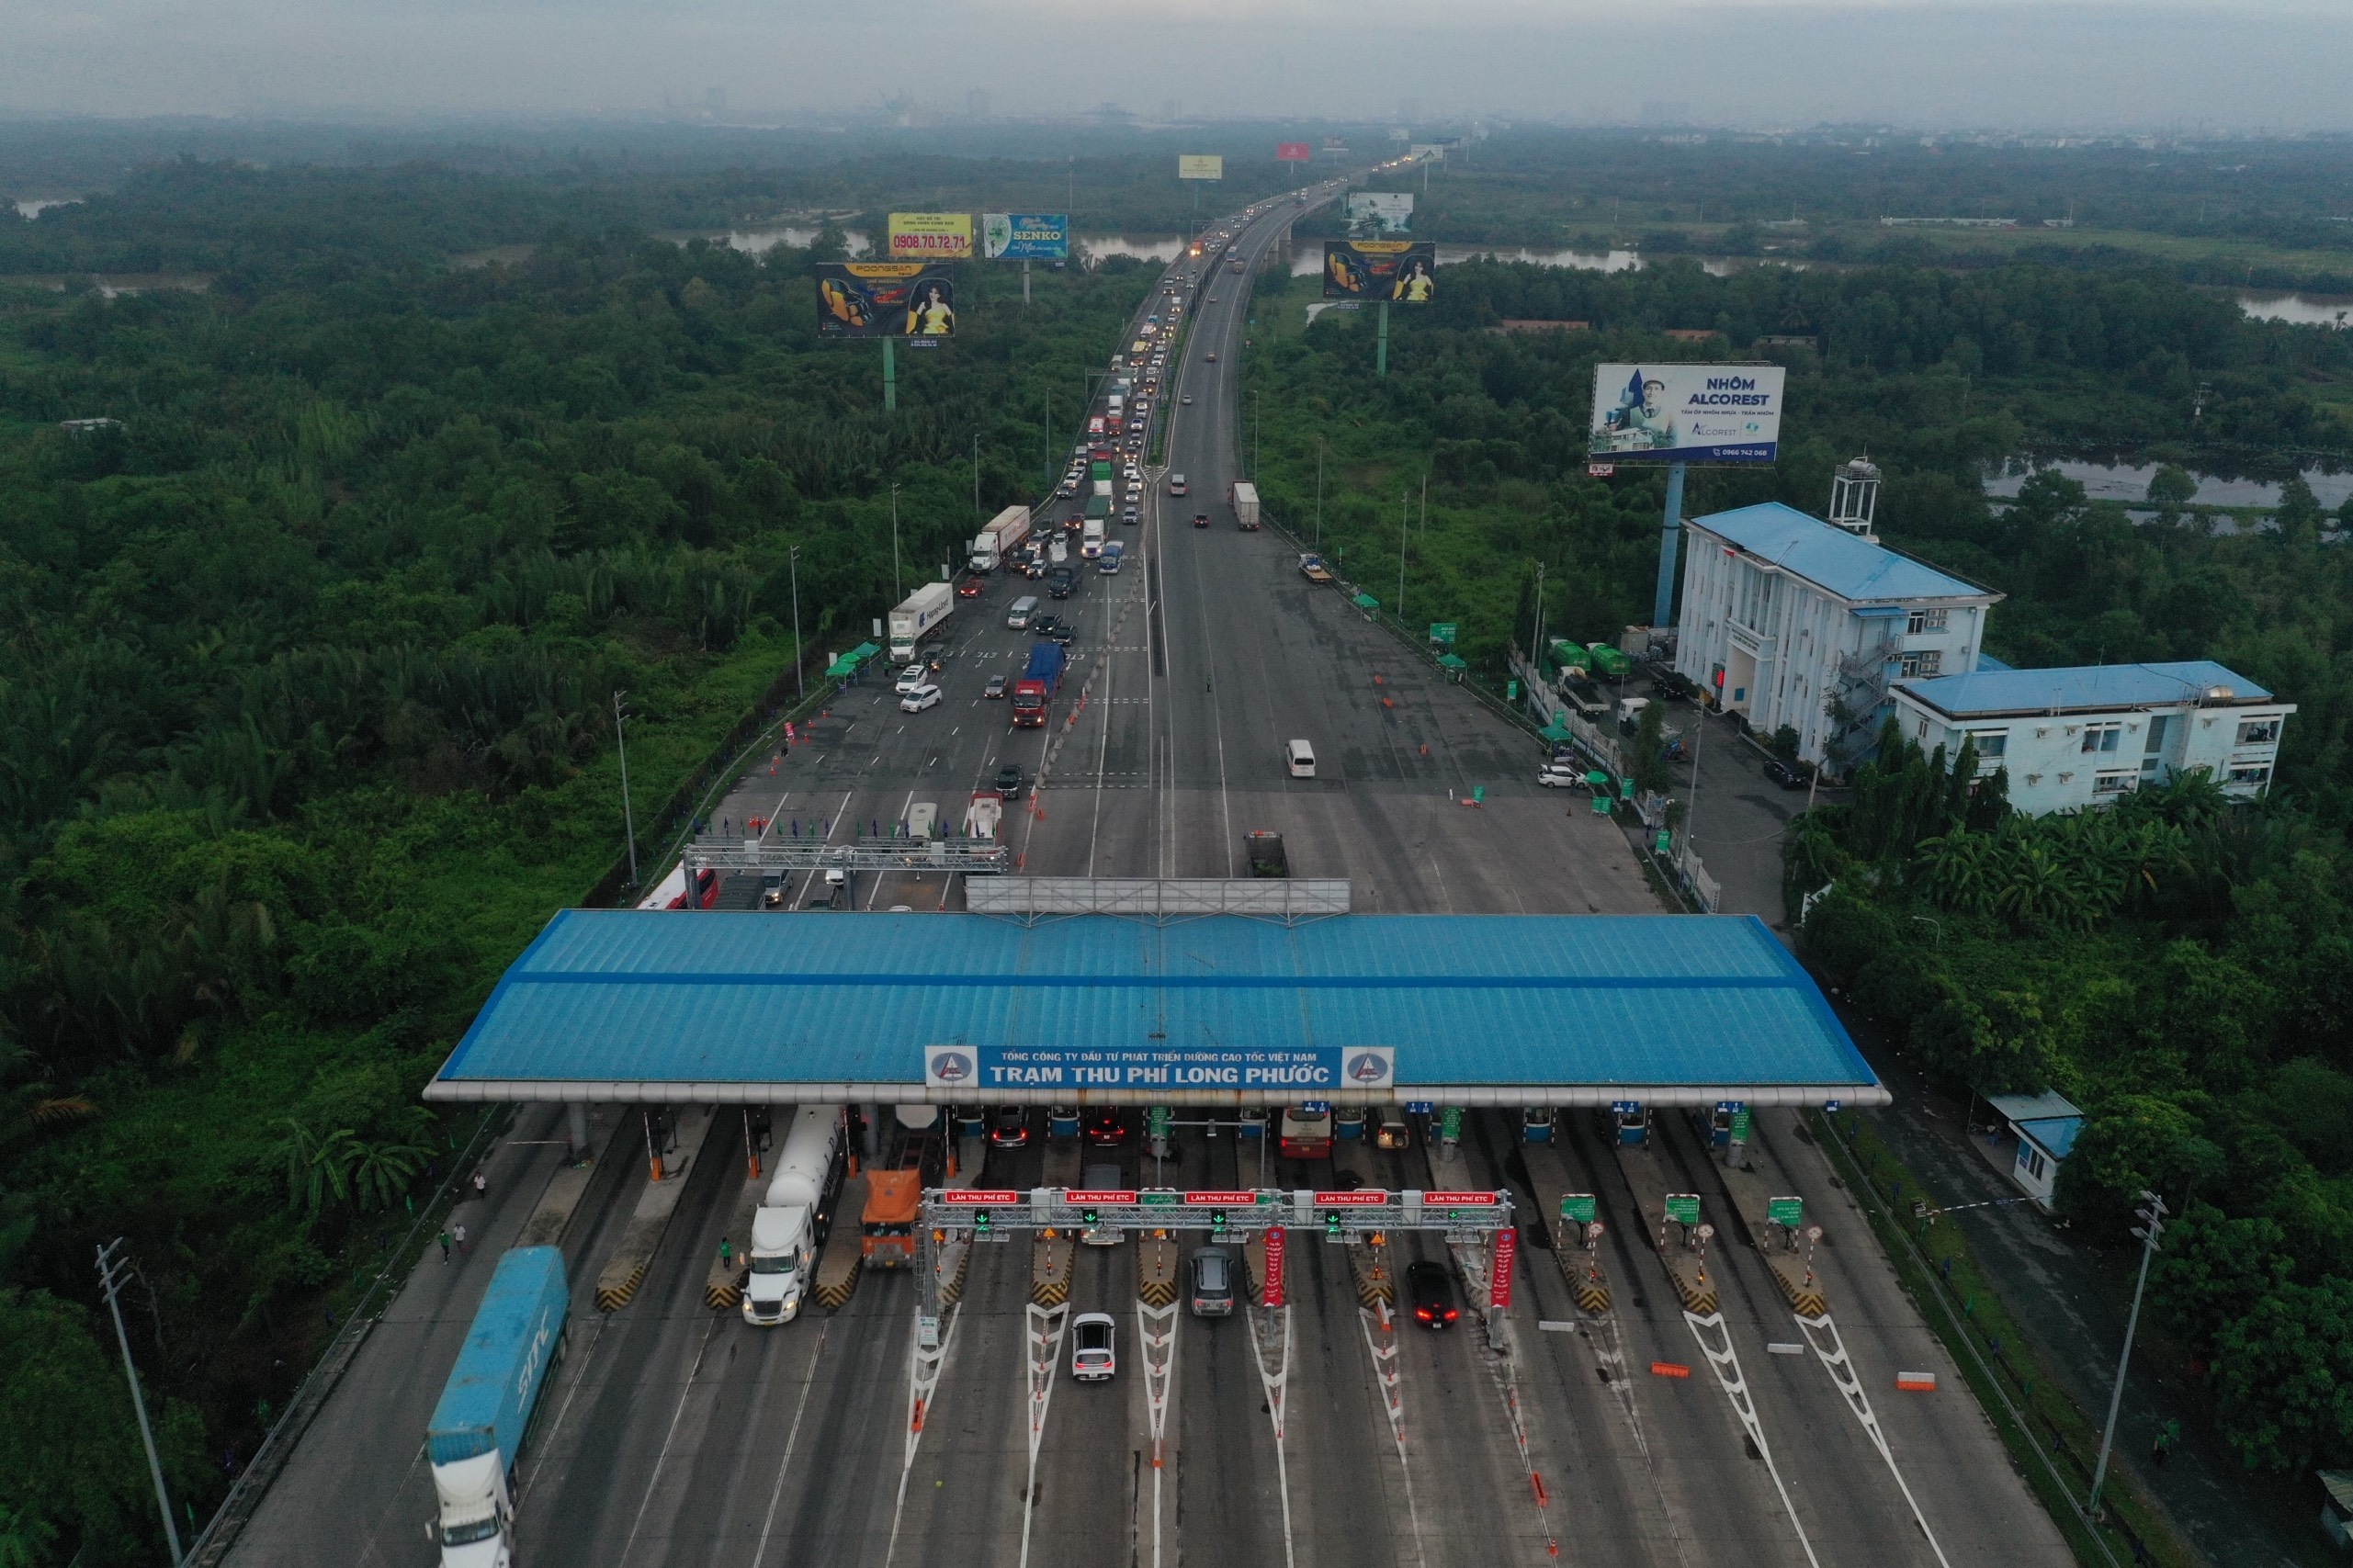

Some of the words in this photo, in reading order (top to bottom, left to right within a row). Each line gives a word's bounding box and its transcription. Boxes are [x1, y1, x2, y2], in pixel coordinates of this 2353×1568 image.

[894, 235, 965, 248] 0908.70.72.71
[1013, 231, 1061, 240] SENKO
[1706, 376, 1755, 391] NHÔM
[1688, 393, 1769, 406] ALCOREST
[1691, 423, 1736, 436] ALCOREST
[927, 598, 948, 620] Hapag-Lloyd
[1001, 1049, 1028, 1062] TỔNG
[1032, 1051, 1061, 1062] CÔNG
[1065, 1053, 1077, 1061] TY
[1081, 1050, 1101, 1061] ĐẦU
[1105, 1052, 1119, 1061] TƯ
[1122, 1050, 1148, 1062] PHÁT
[1152, 1049, 1181, 1062] TRIỂN
[1221, 1053, 1241, 1062] CAO
[1245, 1050, 1265, 1062] TỐC
[1268, 1051, 1290, 1064] VIỆT
[1293, 1053, 1316, 1062] NAM
[990, 1067, 1062, 1085] TRẠM
[1071, 1067, 1120, 1083] THU
[1128, 1063, 1170, 1083] PHÍ
[1175, 1067, 1238, 1083] LONG
[1246, 1063, 1329, 1083] PHƯỚC
